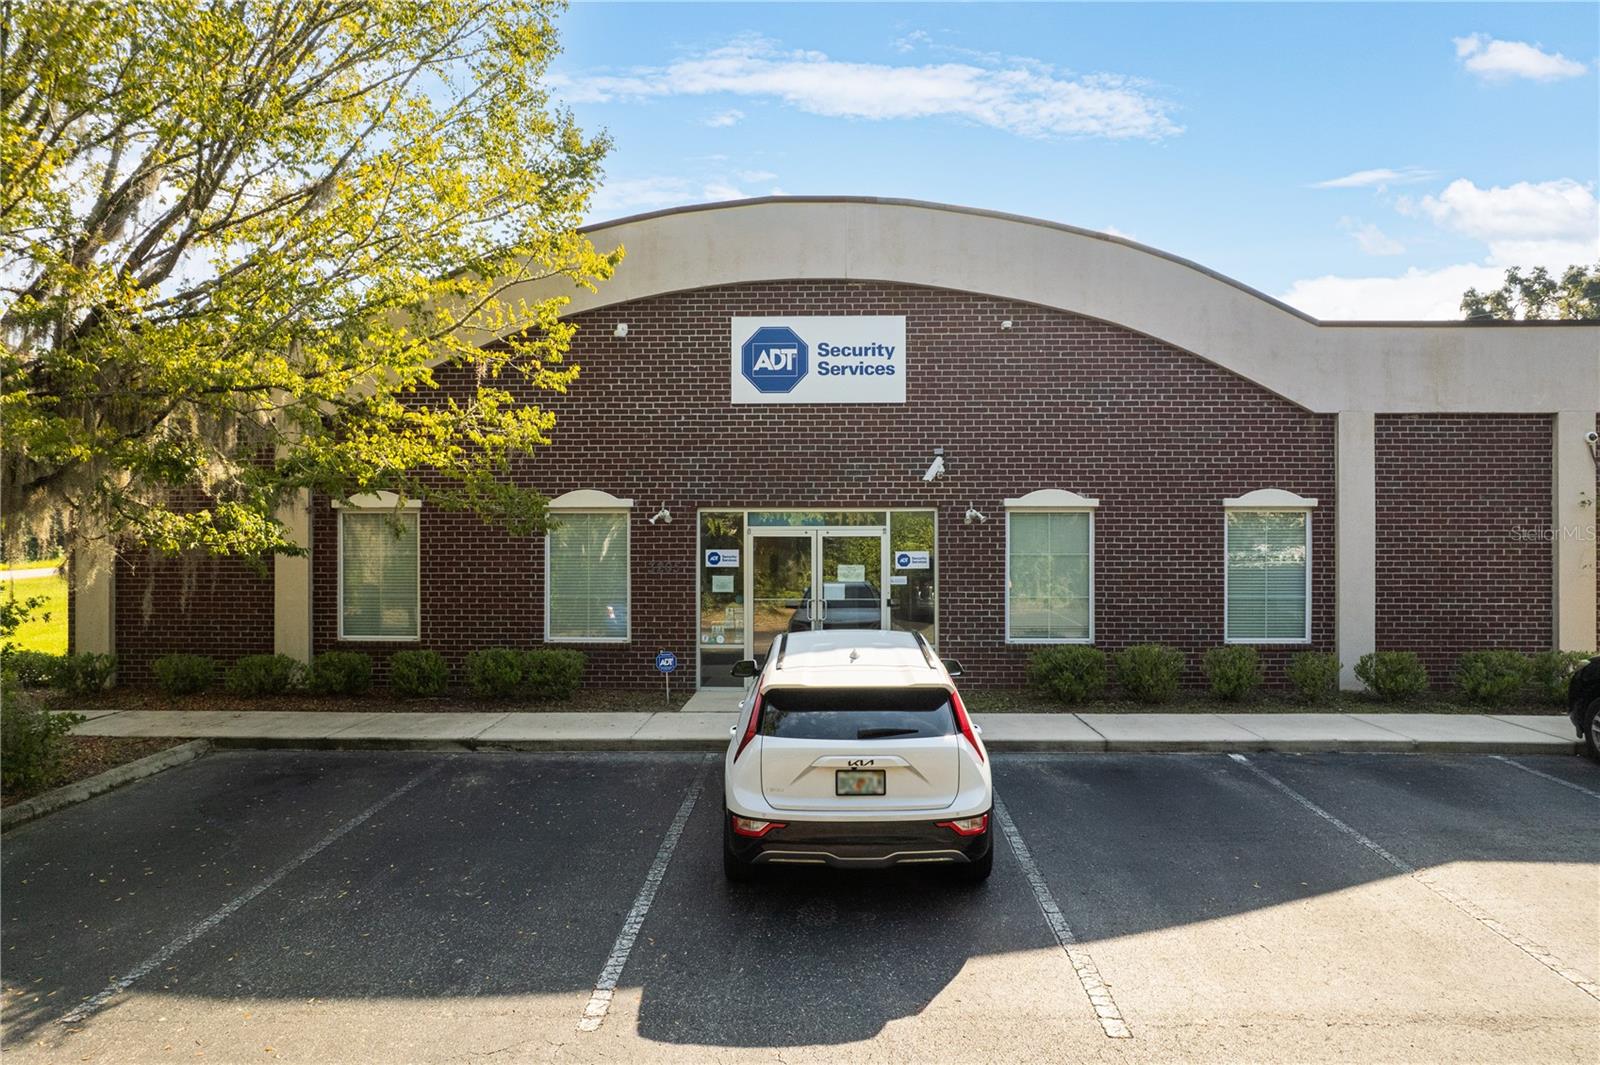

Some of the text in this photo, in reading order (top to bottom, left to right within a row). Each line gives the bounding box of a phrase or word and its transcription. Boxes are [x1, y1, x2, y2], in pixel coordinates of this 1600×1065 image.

[817, 342, 896, 360] Security
[753, 348, 798, 371] ADT
[817, 361, 896, 376] Services
[660, 658, 674, 666] ADT
[848, 759, 874, 767] KIA
